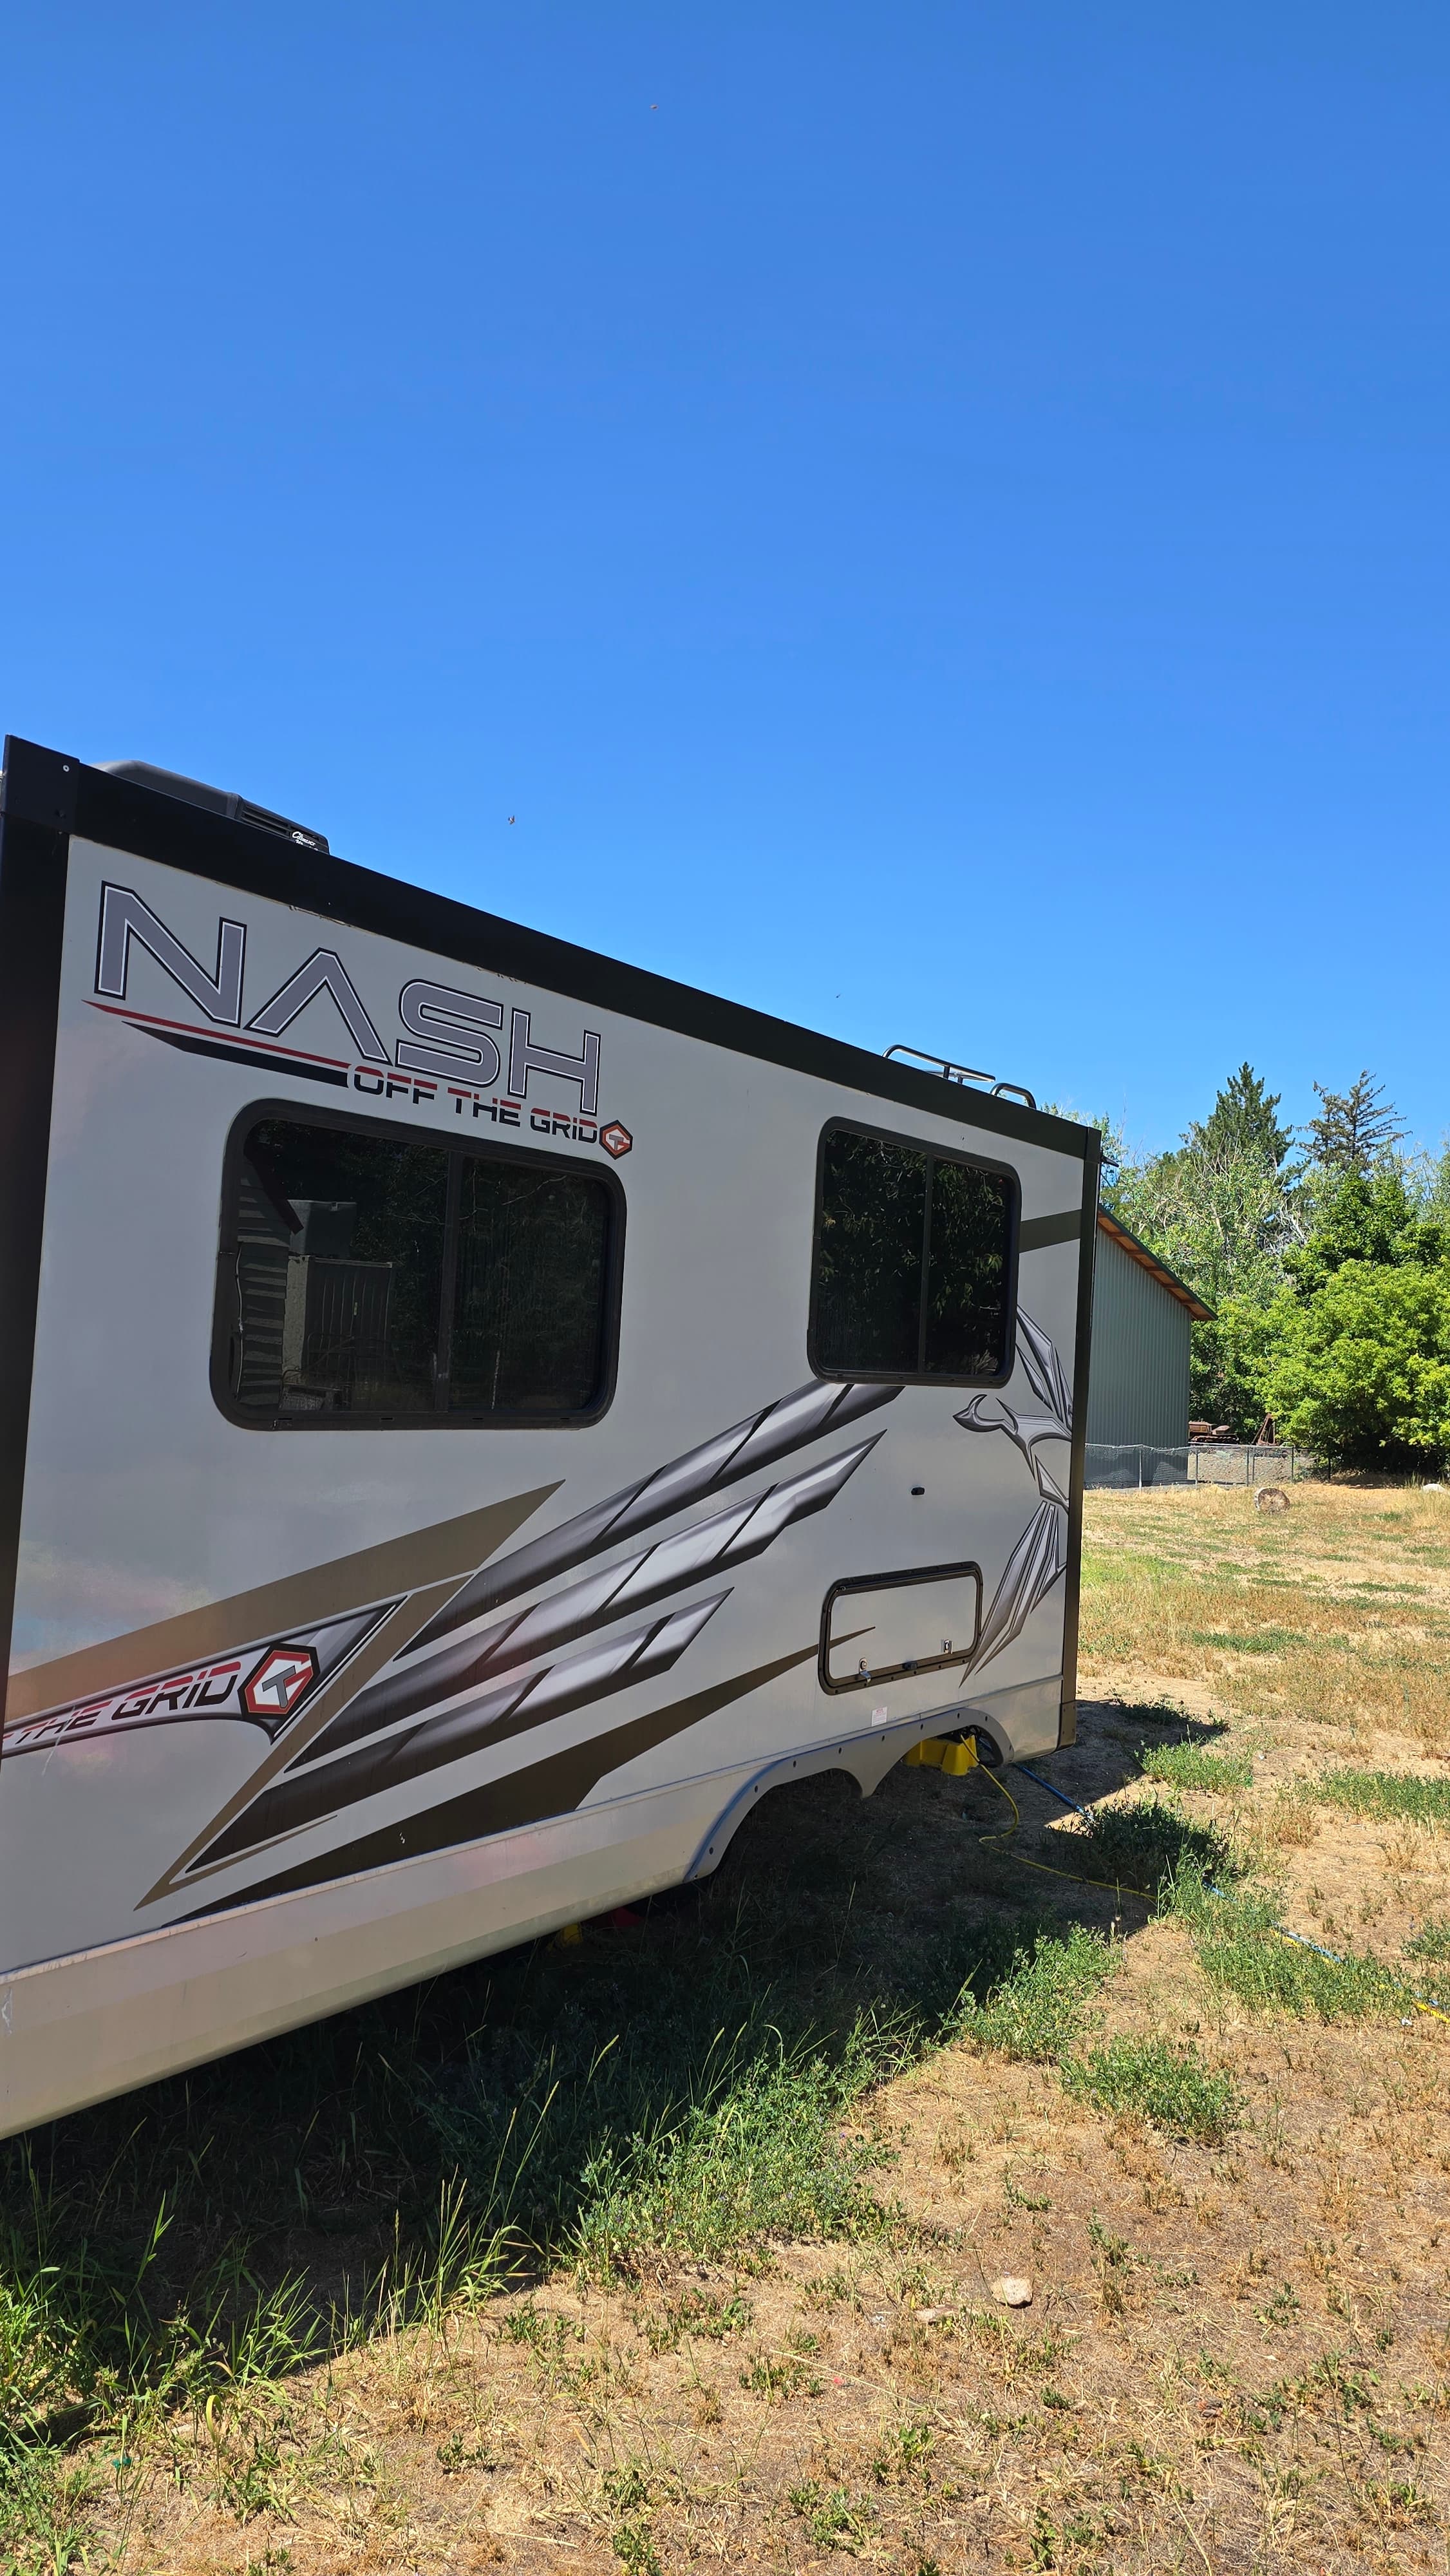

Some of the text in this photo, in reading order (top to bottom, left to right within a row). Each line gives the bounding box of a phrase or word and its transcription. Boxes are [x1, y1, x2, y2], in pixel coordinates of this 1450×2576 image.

[94, 880, 601, 1116] NASH
[353, 1065, 598, 1143] OFF THE GRID
[15, 1661, 241, 1745] THE GRID
